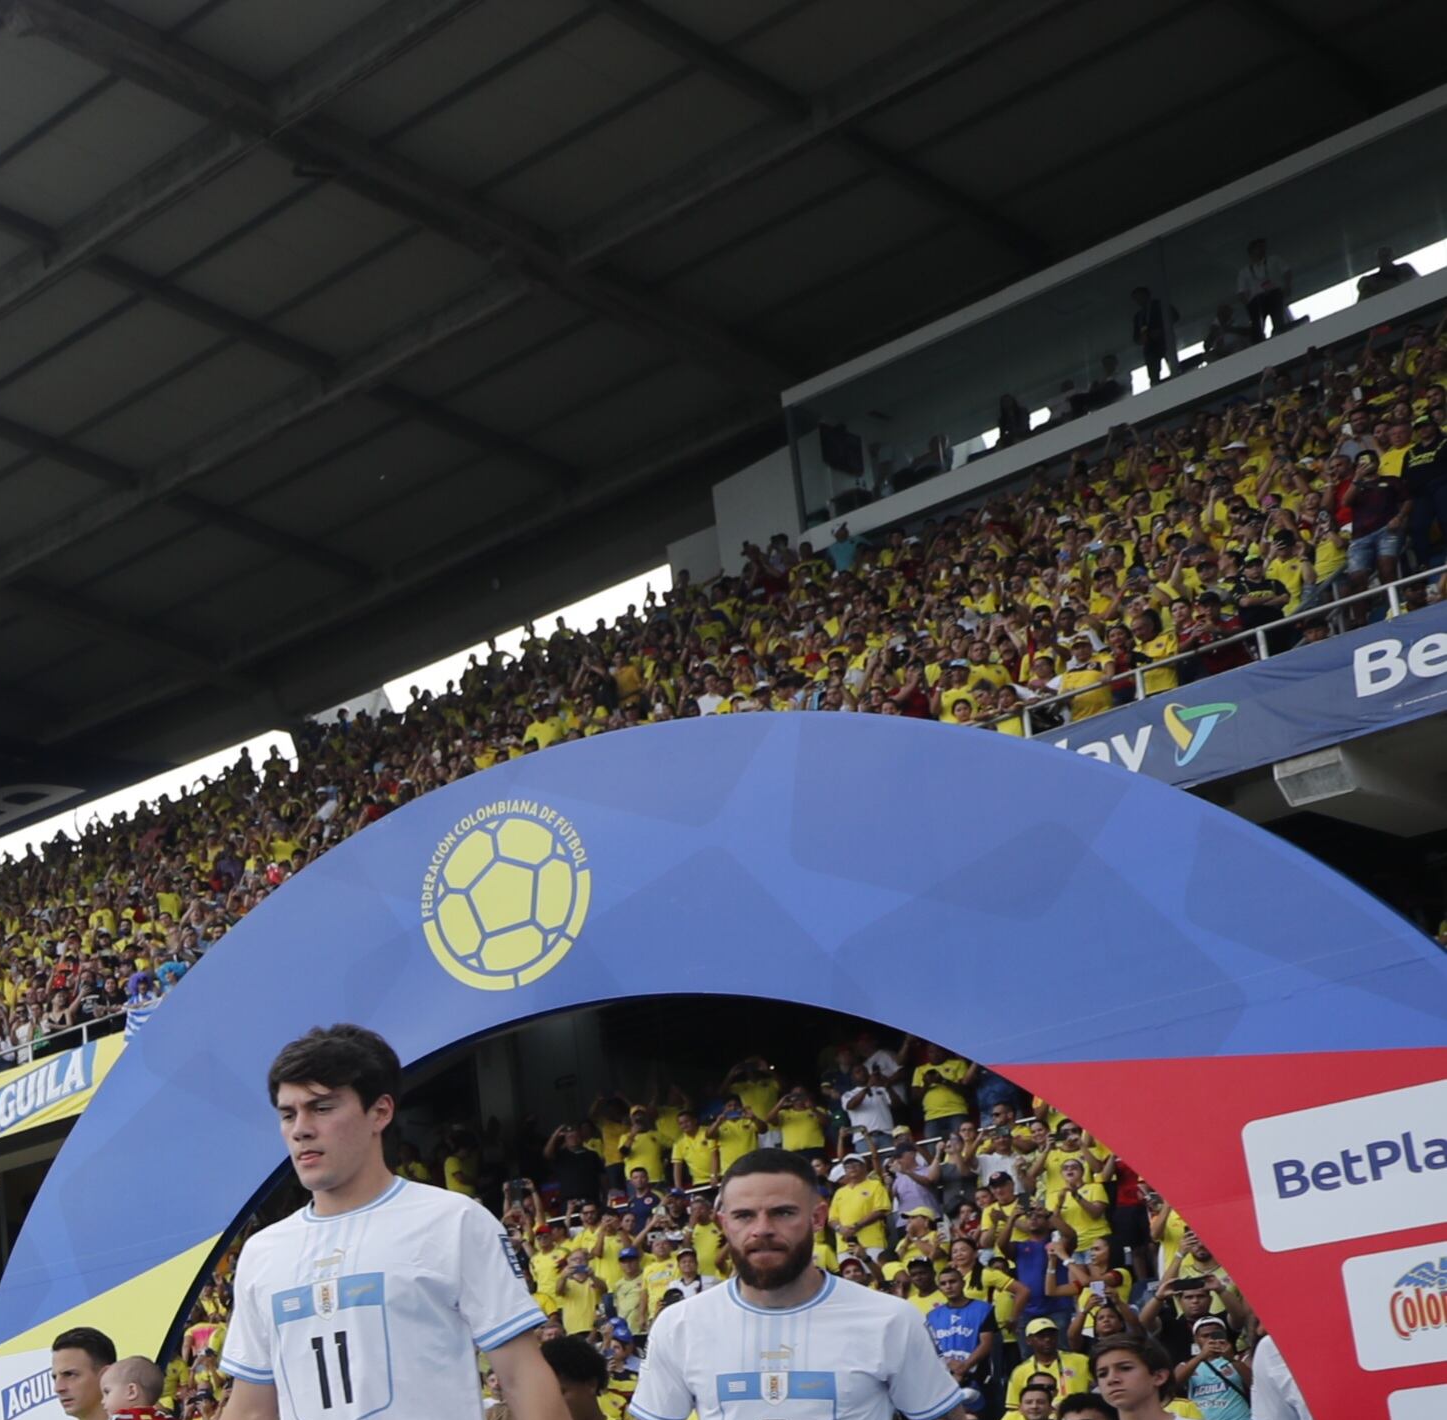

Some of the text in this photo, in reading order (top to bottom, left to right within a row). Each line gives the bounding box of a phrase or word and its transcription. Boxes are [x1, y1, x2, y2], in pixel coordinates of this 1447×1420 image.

[421, 800, 587, 917] FEDERACIÓN COLOMBIANA DE FÚTBOL
[311, 1331, 353, 1409] 11
